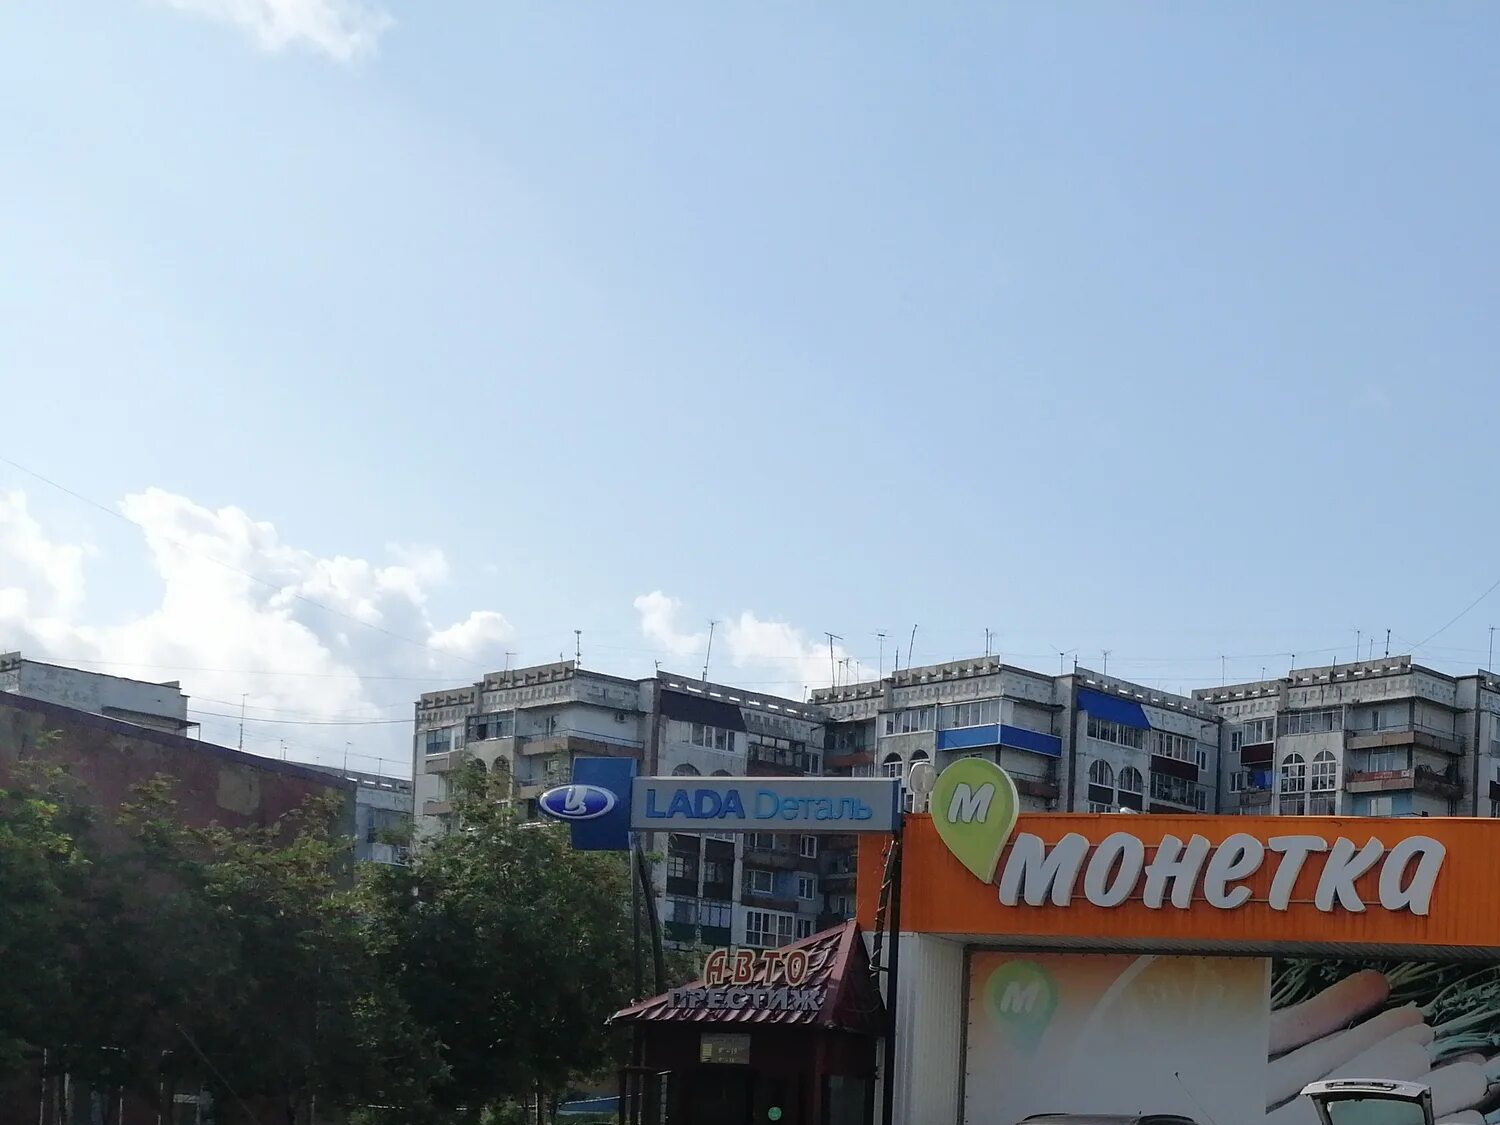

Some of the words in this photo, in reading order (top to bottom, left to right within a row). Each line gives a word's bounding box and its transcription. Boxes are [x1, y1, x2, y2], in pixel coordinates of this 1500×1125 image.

[645, 789, 745, 819] LADA
[704, 949, 808, 987] АВТО
[667, 988, 823, 1012] ПРЕСТИЖ
